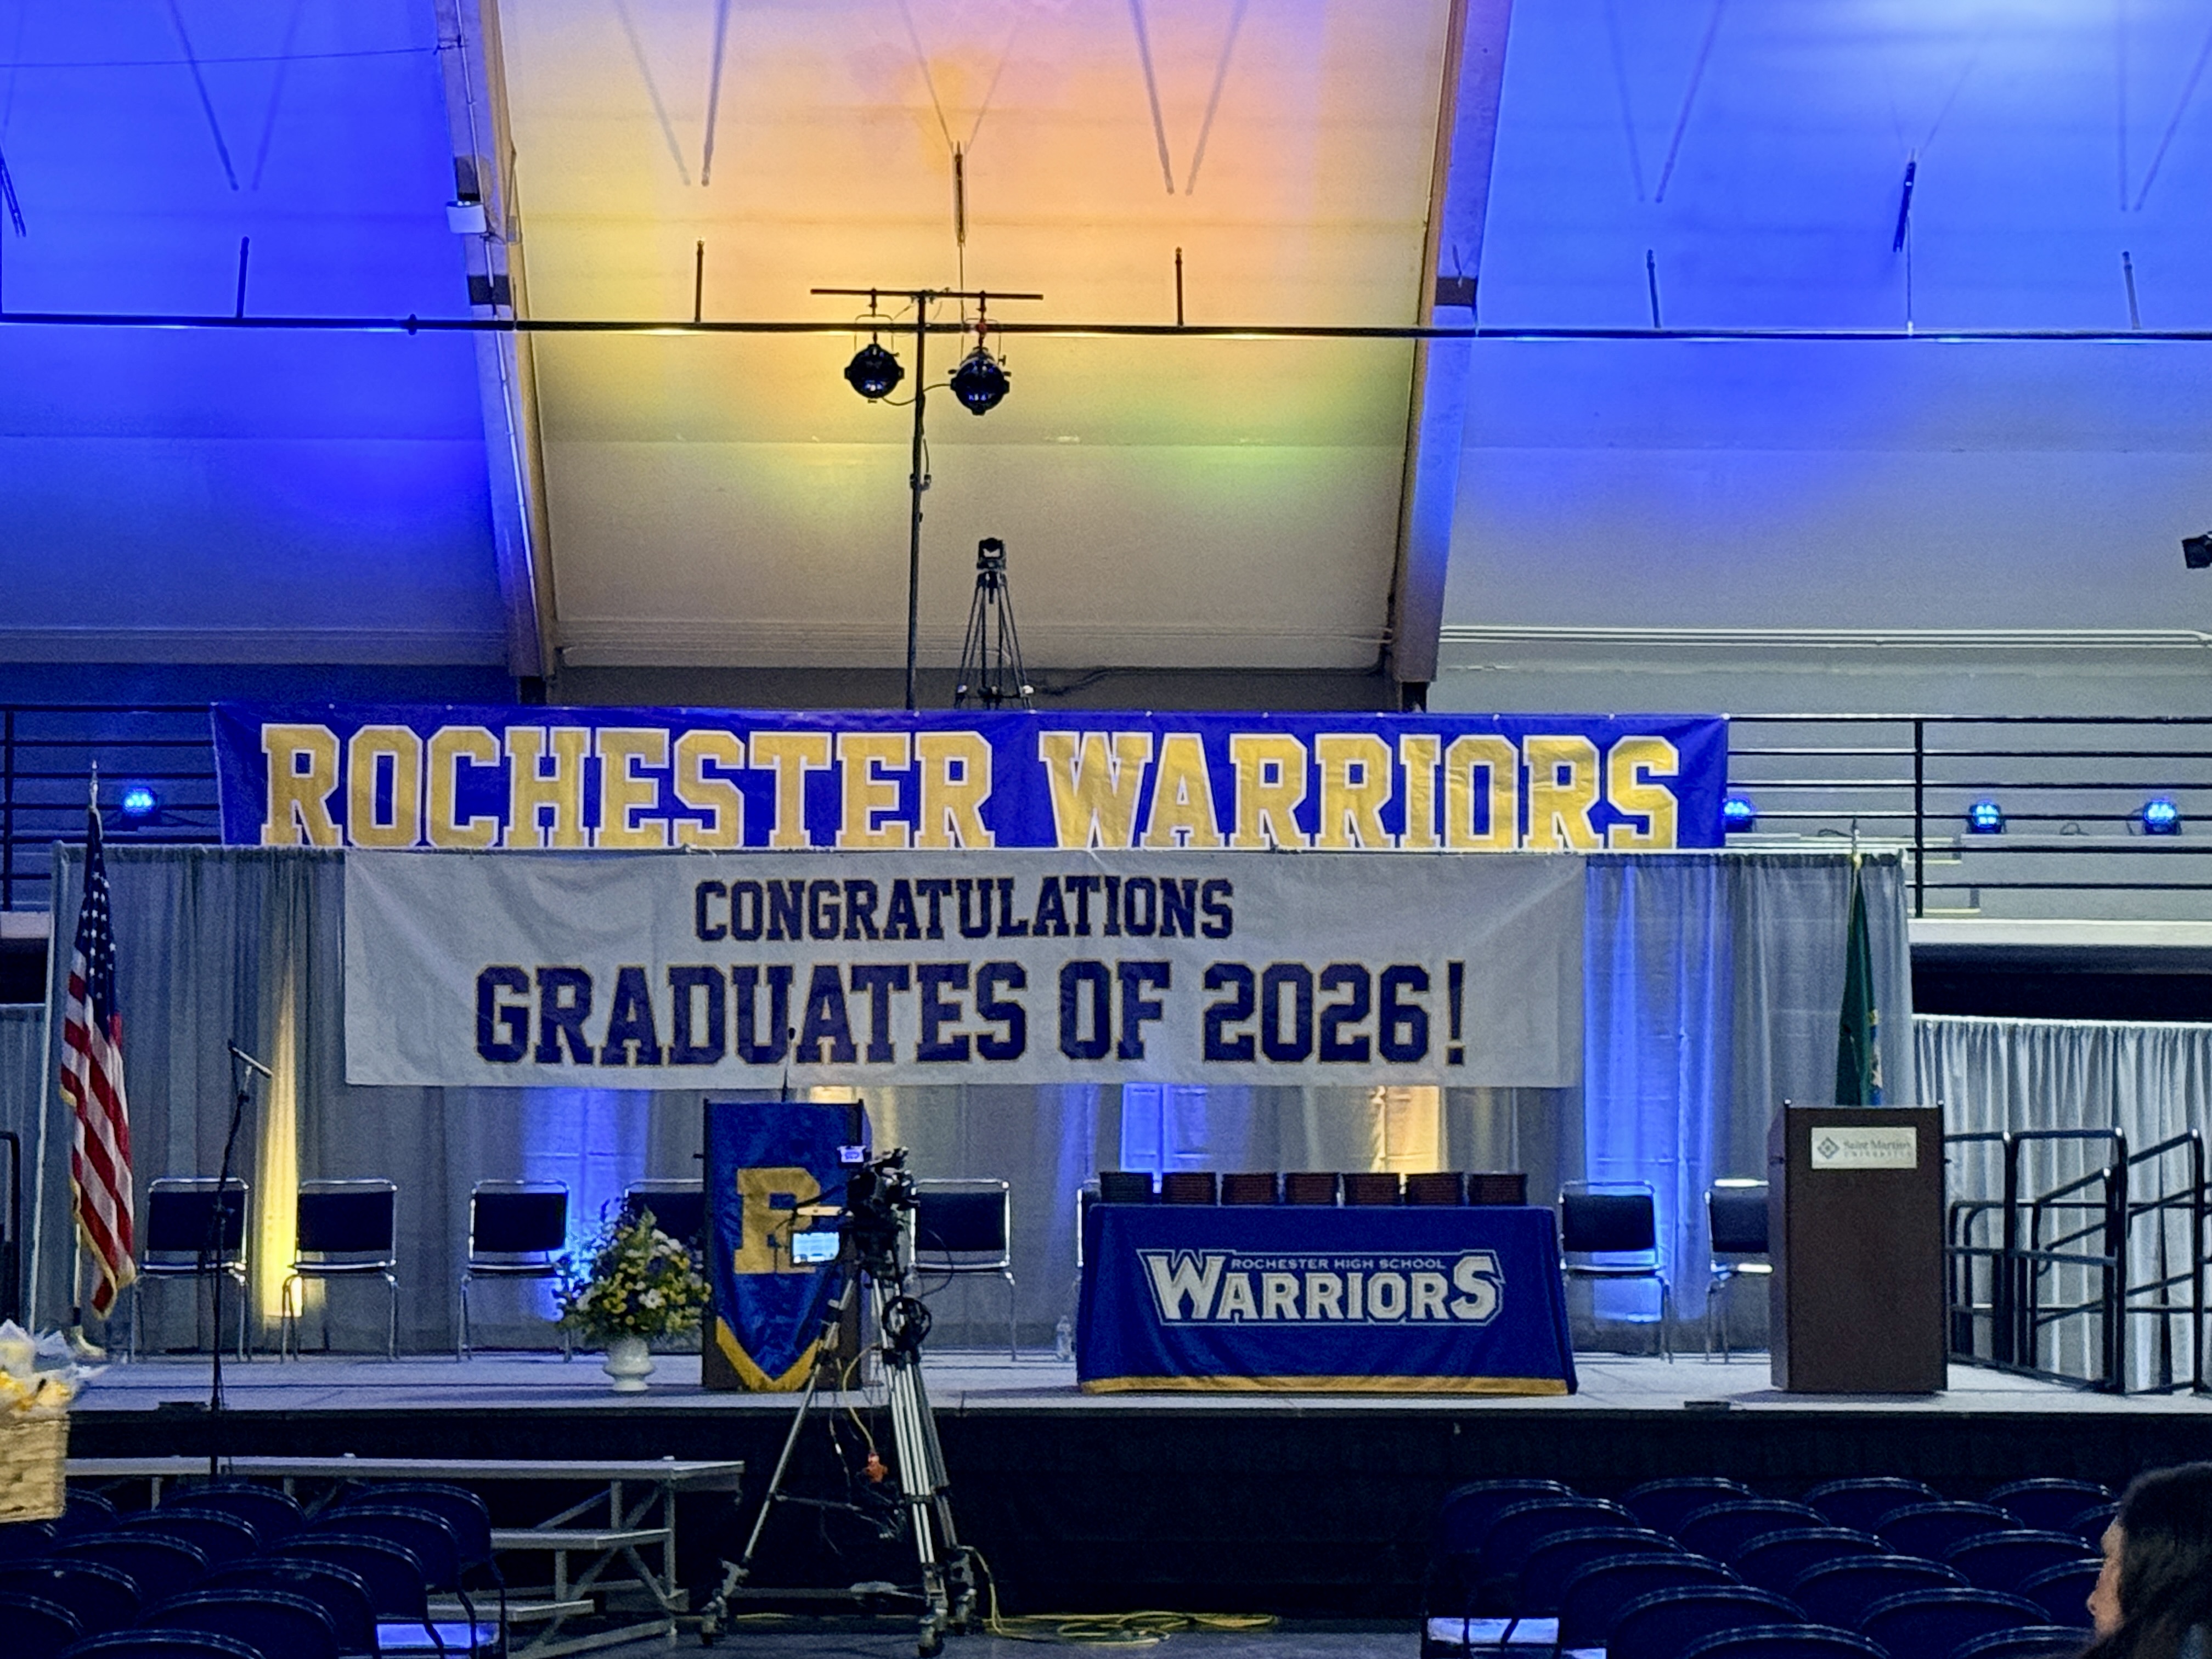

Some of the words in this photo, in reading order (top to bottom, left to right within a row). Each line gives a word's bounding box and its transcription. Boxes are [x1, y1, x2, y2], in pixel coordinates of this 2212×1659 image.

[261, 723, 995, 848] ROCHESTER
[1039, 730, 1679, 849] WARRIORS
[695, 875, 1234, 942] CONGRATULATIONS
[475, 961, 1029, 1066] GRADUATES
[1058, 959, 1172, 1062] OF
[1202, 960, 1465, 1065] 2026!
[1147, 1255, 1496, 1320] WARRIORS
[1231, 1259, 1329, 1270] ROCHESTER
[1334, 1259, 1374, 1269] HIGH
[1379, 1259, 1446, 1269] SCHOOL
